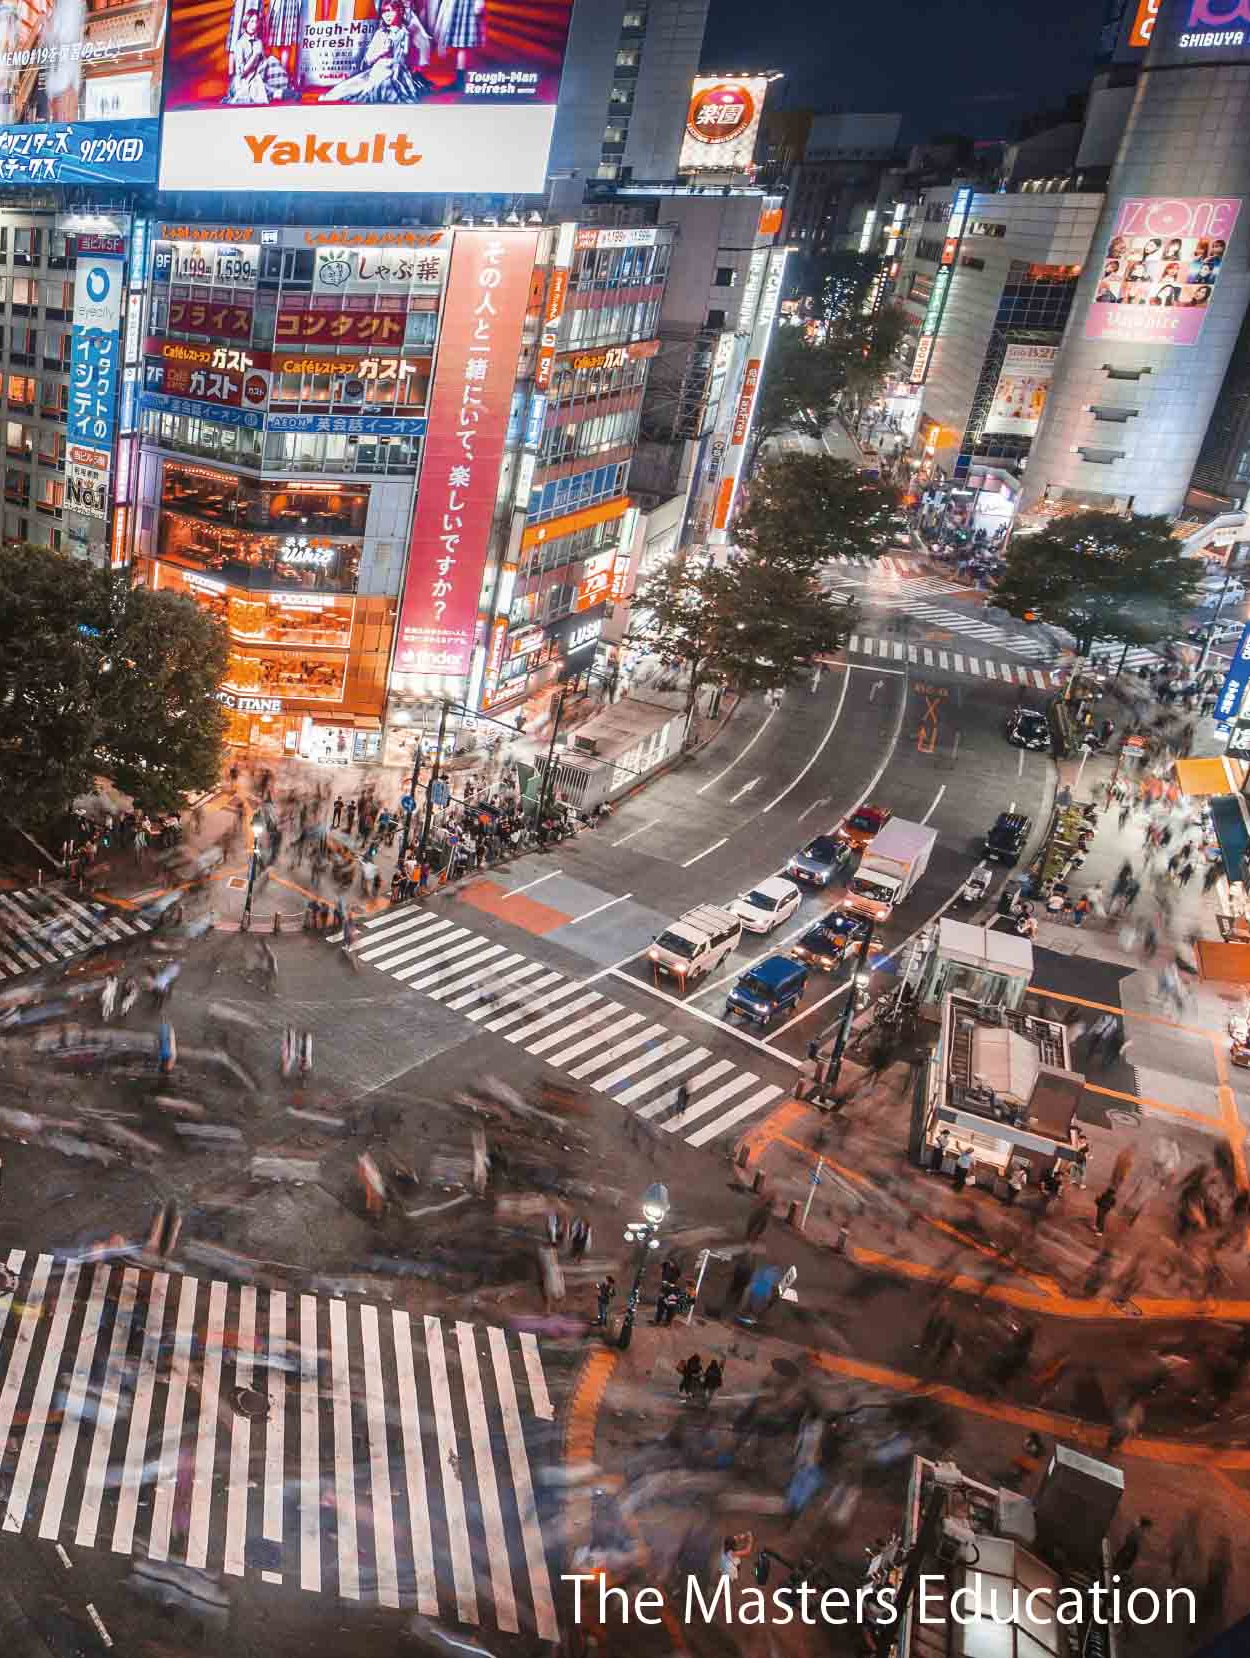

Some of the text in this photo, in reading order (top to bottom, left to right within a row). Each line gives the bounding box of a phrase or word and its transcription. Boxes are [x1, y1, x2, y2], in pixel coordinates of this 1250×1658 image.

[304, 23, 374, 37] Tough-Man
[302, 36, 354, 48] Refresh
[1179, 31, 1244, 47] SHIBUYA
[468, 71, 538, 84] Tough-Man
[464, 83, 516, 94] Refresh
[81, 139, 144, 163] 9/29(日)
[244, 133, 424, 166] Yakult
[156, 253, 171, 268] 9F
[358, 255, 440, 281] しゃぶ葉
[277, 313, 401, 339] コンタクト
[211, 347, 254, 373] ガスト
[357, 357, 417, 380] ガスト
[146, 367, 165, 382] 7F
[190, 370, 238, 400] ガスト
[317, 416, 423, 433] 英会話イーオン
